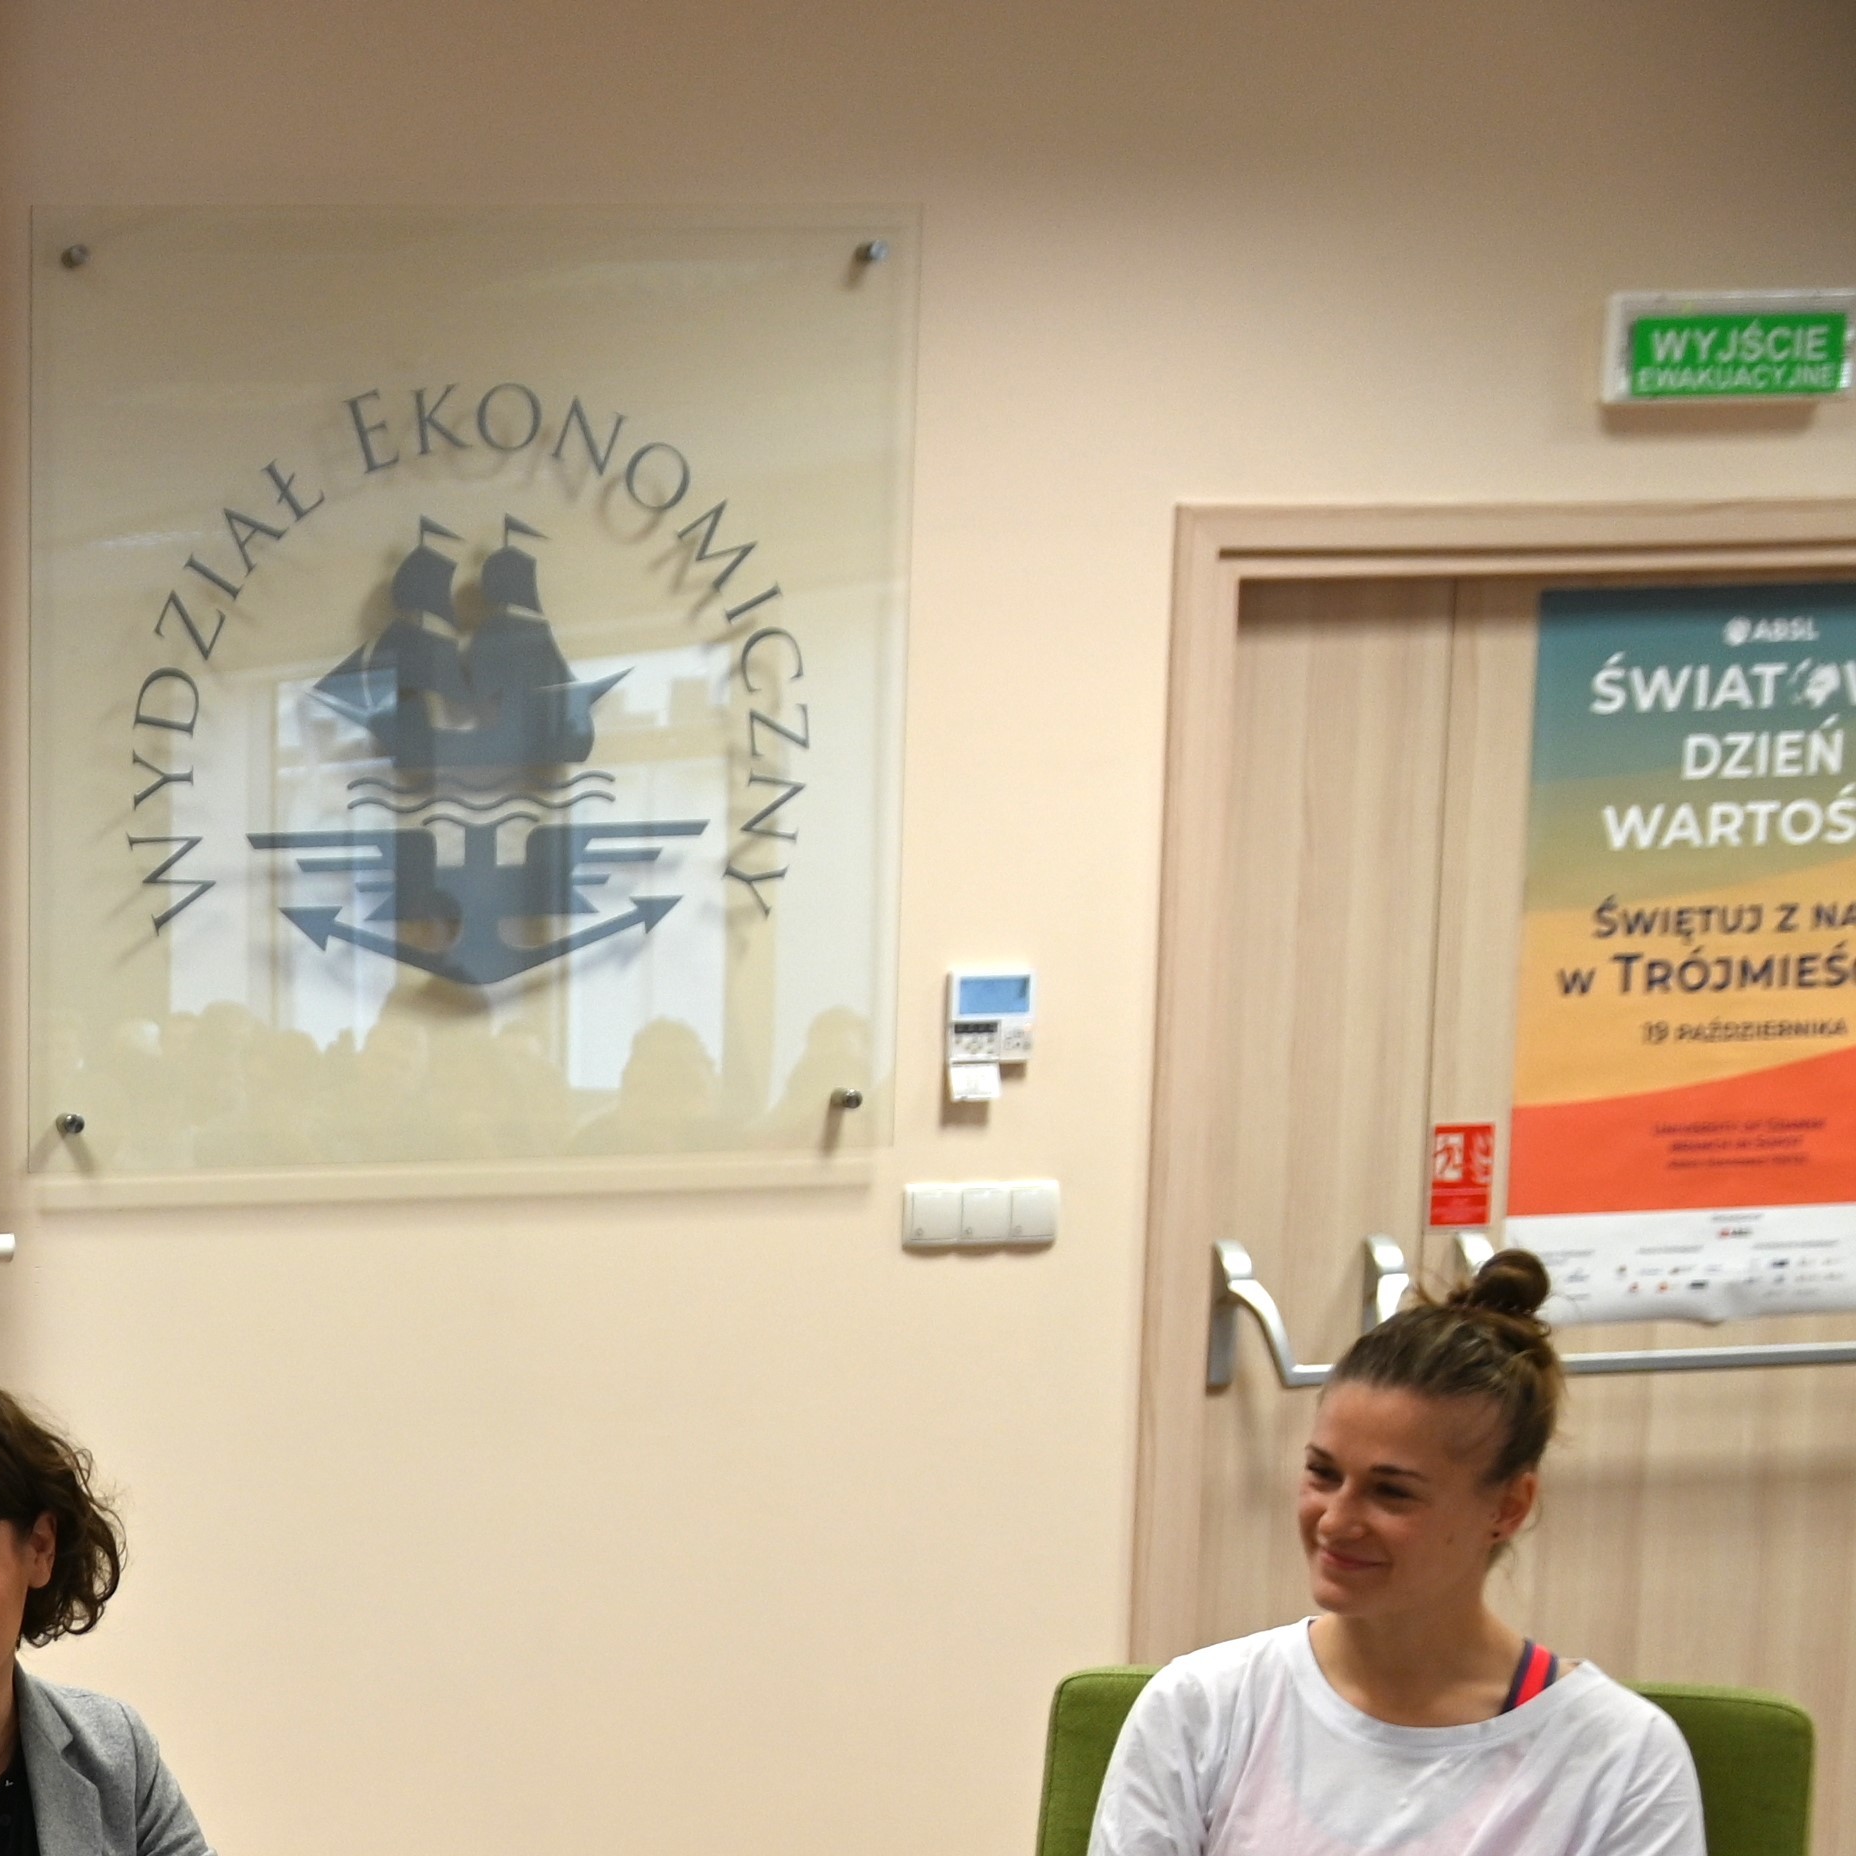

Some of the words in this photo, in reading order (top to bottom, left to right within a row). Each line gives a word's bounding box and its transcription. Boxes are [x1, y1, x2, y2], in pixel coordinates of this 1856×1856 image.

[1652, 319, 1830, 362] WYJŚCIE
[1639, 363, 1834, 391] EWAKUACYJNE
[126, 458, 326, 936] WYDZIAŁ
[342, 382, 811, 919] EKONOMICZNY
[1591, 651, 1856, 714] ŚWIATO
[1682, 713, 1844, 781] DZIEŃ
[1593, 893, 1763, 945] ŚWIĘTUJ
[1775, 902, 1800, 932] Z
[1610, 940, 1856, 996] TRÓJMIEŚ
[1642, 1021, 1669, 1044] 19
[1676, 1016, 1848, 1042] PAŹDZIERNIKA
